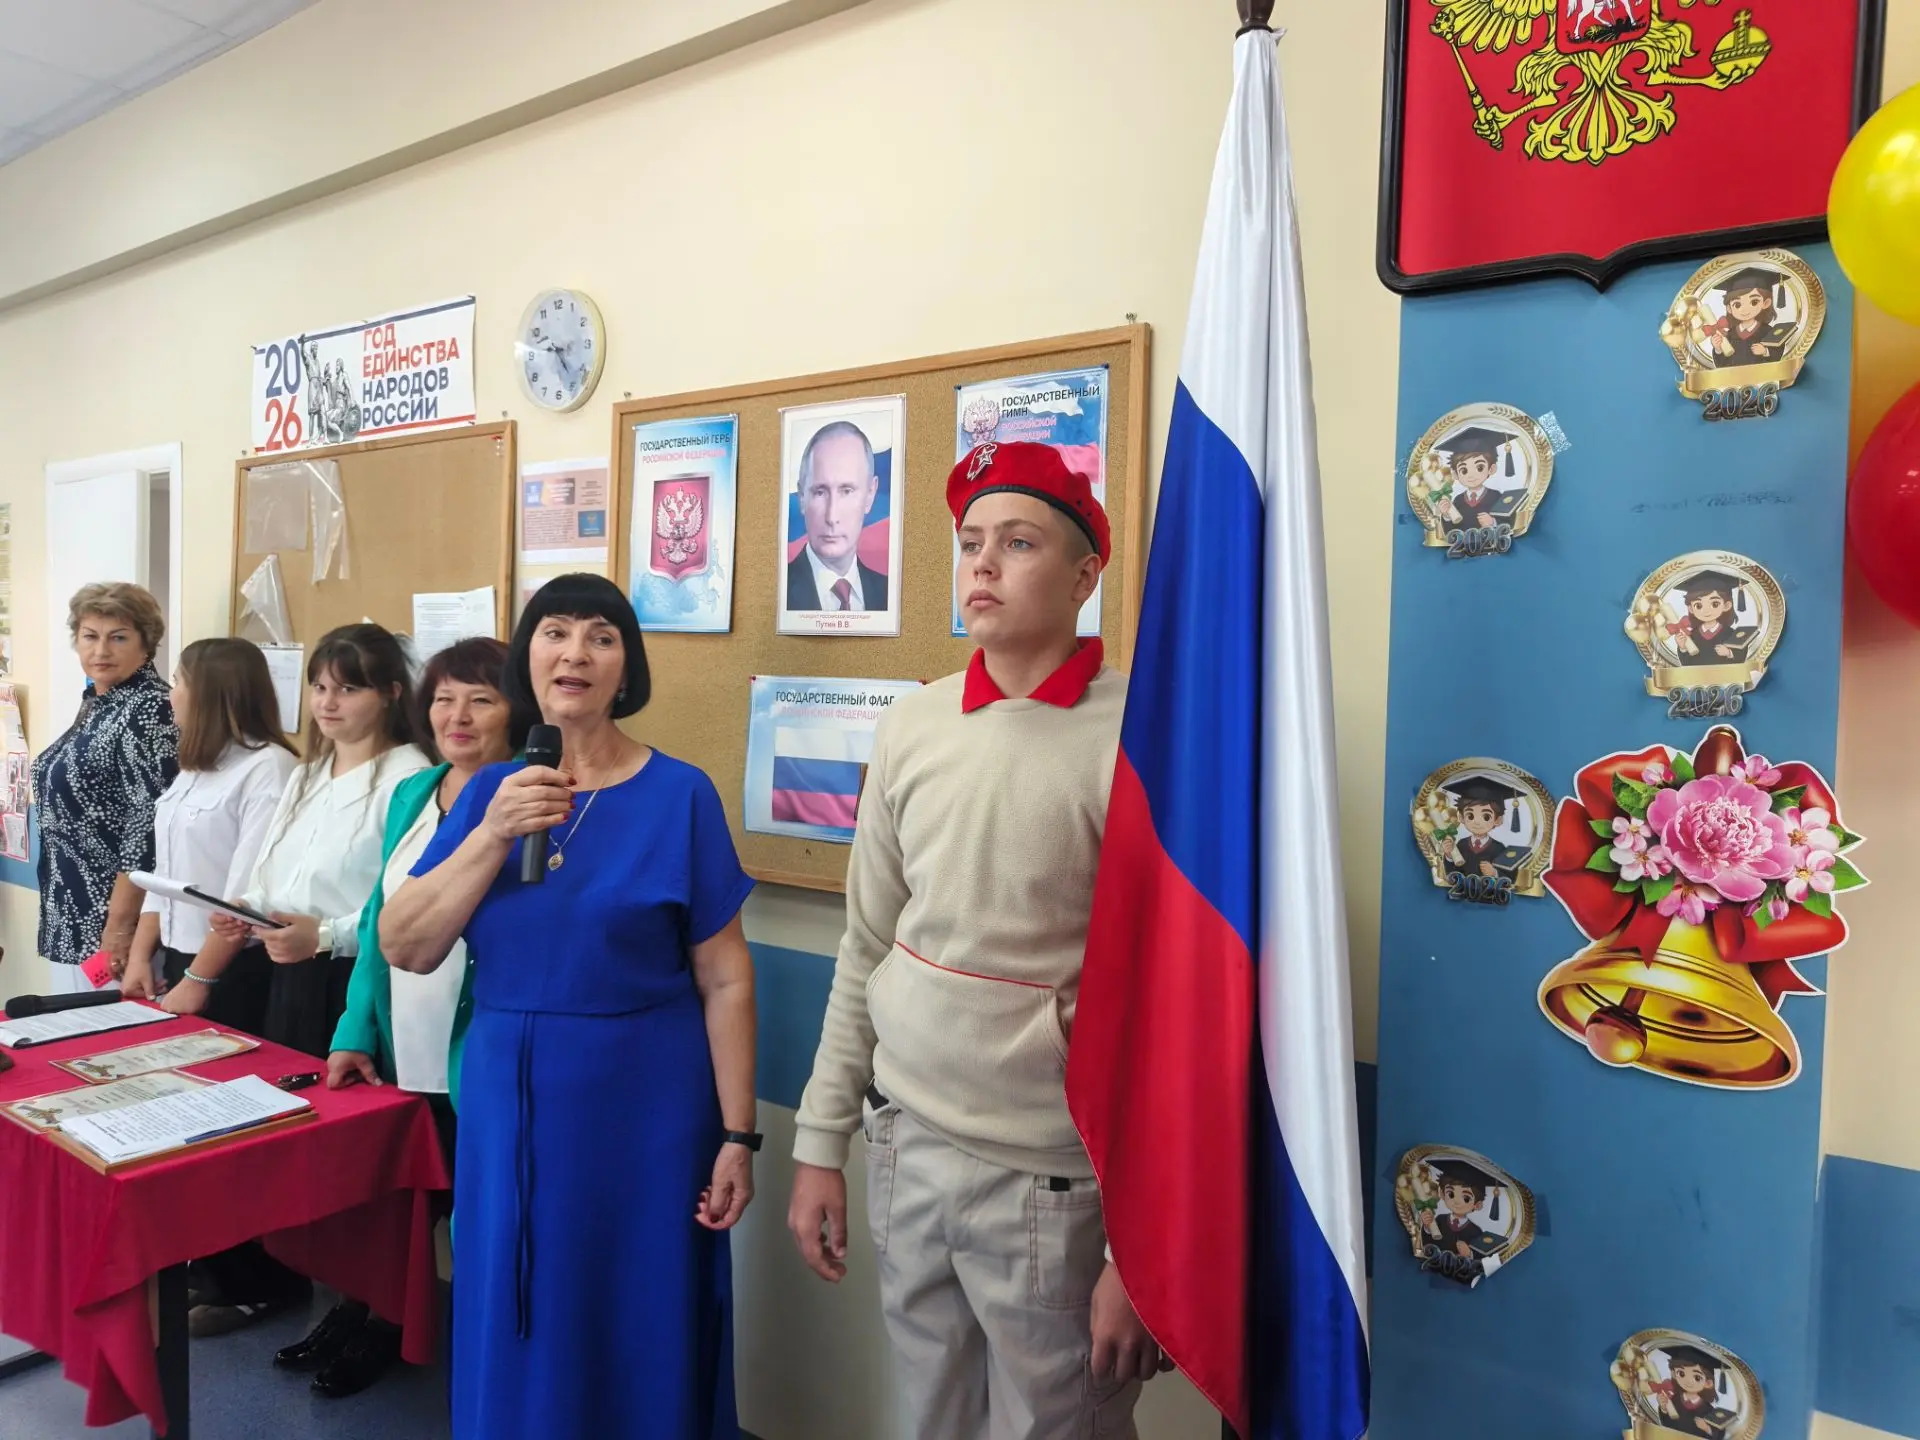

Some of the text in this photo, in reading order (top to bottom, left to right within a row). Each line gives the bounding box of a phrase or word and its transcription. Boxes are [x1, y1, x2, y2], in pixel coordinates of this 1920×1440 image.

[540, 308, 547, 319] 11
[553, 299, 563, 310] 12
[580, 317, 587, 327] 2
[364, 322, 396, 351] ГОД
[584, 339, 591, 349] 3
[265, 339, 301, 398] 20
[363, 337, 460, 379] ЕДИНСТВА
[363, 367, 449, 404] НАРОДОВ
[531, 372, 538, 382] 8
[541, 387, 547, 397] 7
[555, 390, 562, 400] 6
[1002, 384, 1100, 407] ГОСУДАРСТВЕННЫЙ
[1700, 382, 1779, 421] 2026
[265, 395, 303, 450] 26
[362, 396, 438, 429] РОССИИ
[1002, 407, 1028, 418] ГИМН
[640, 433, 731, 452] ГОСУДАРСТВЕННЫЙ ГЕРБ
[1447, 523, 1511, 558] 2026
[815, 620, 836, 630] Путин
[776, 691, 895, 707] ГОСУДАРСТВЕННЫЙ ФЛАГ
[1667, 684, 1744, 720] 2026
[836, 708, 880, 720] ФЕДЕРАЦИ
[1447, 871, 1512, 906] 2026
[1421, 1243, 1479, 1286] 202
